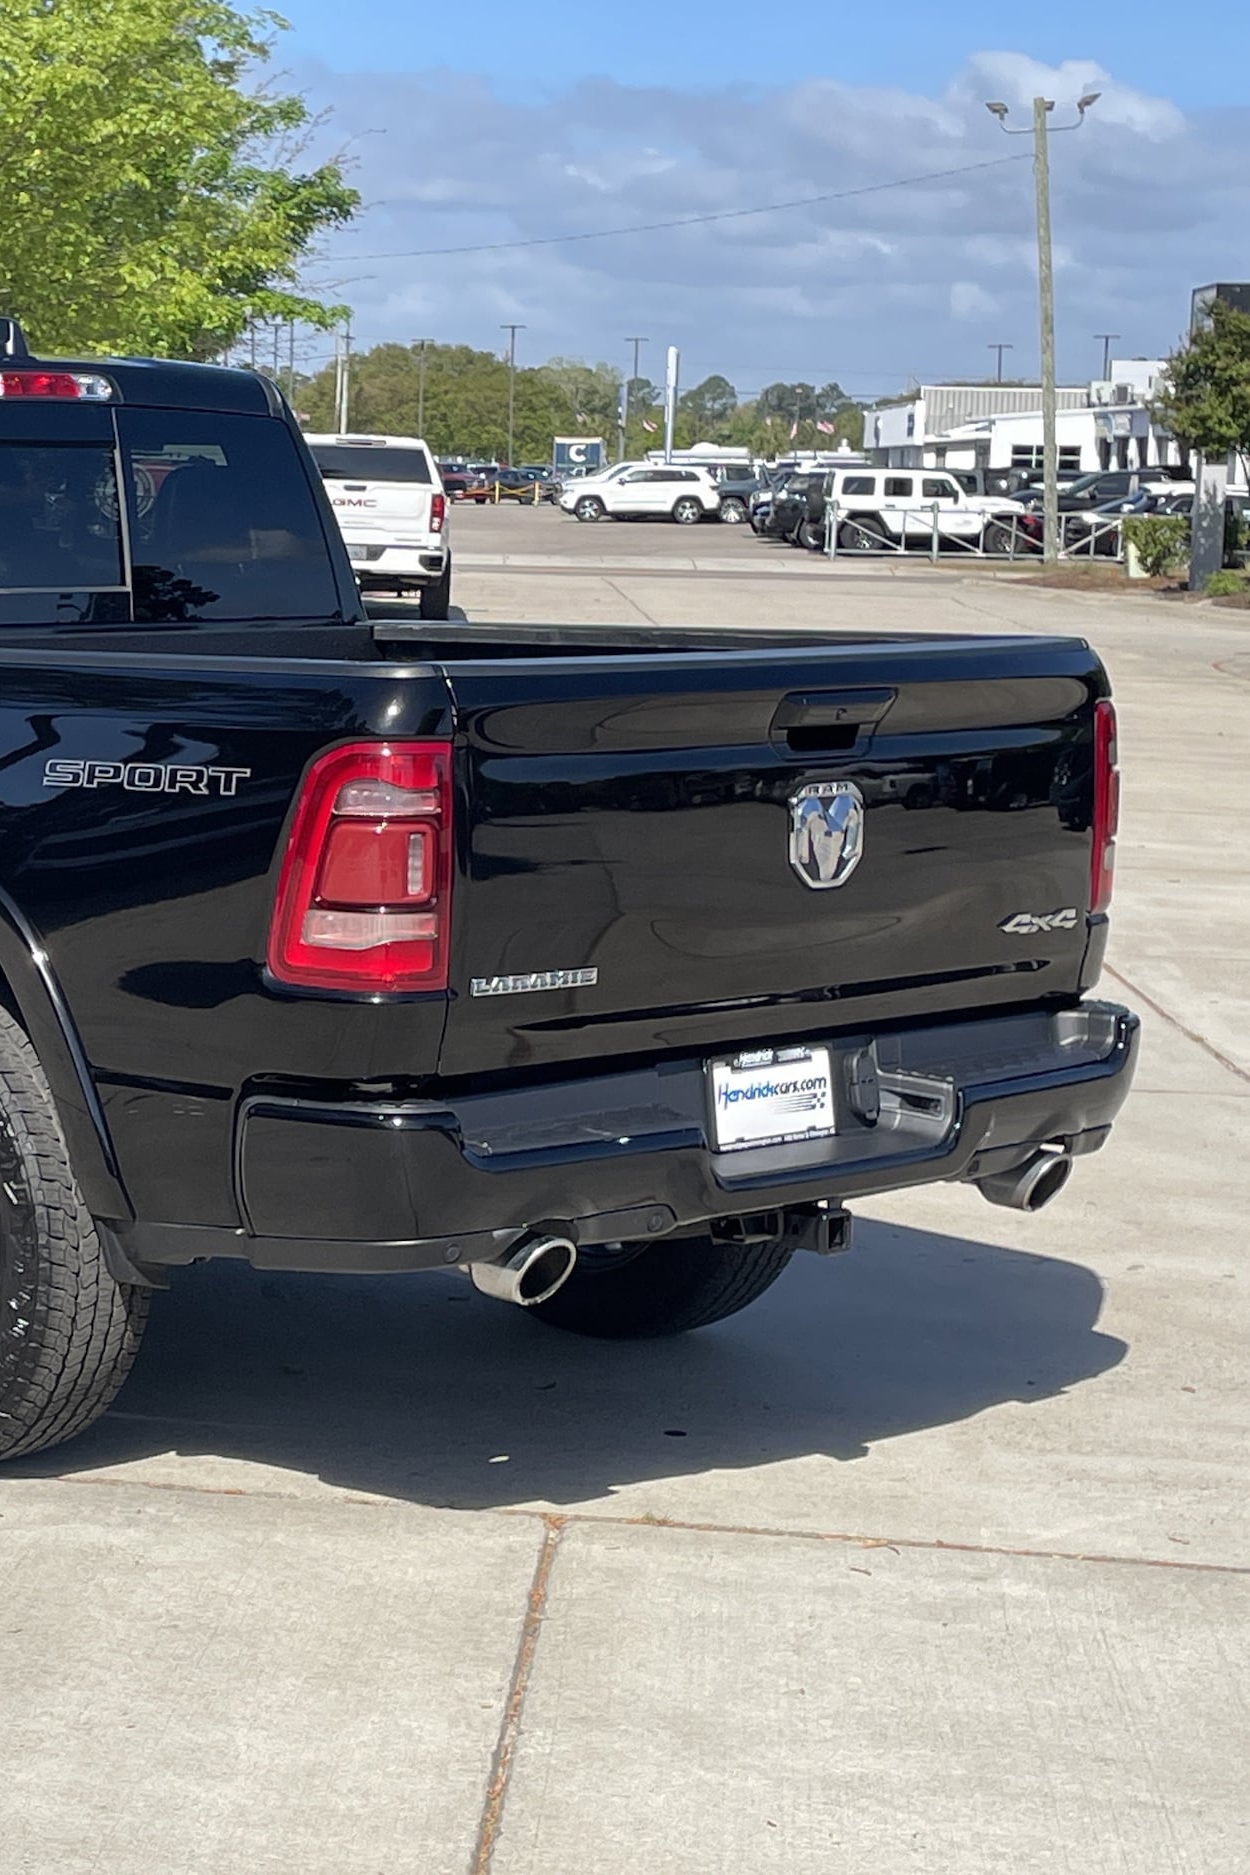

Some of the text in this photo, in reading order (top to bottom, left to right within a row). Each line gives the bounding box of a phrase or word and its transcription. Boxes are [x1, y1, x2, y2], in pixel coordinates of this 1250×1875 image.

[569, 444, 587, 463] C
[332, 498, 377, 508] GMC
[43, 759, 251, 796] SPORT
[807, 783, 849, 795] RAM
[470, 967, 598, 997] LARAMIE
[718, 1076, 827, 1111] Hendrickcars.com
